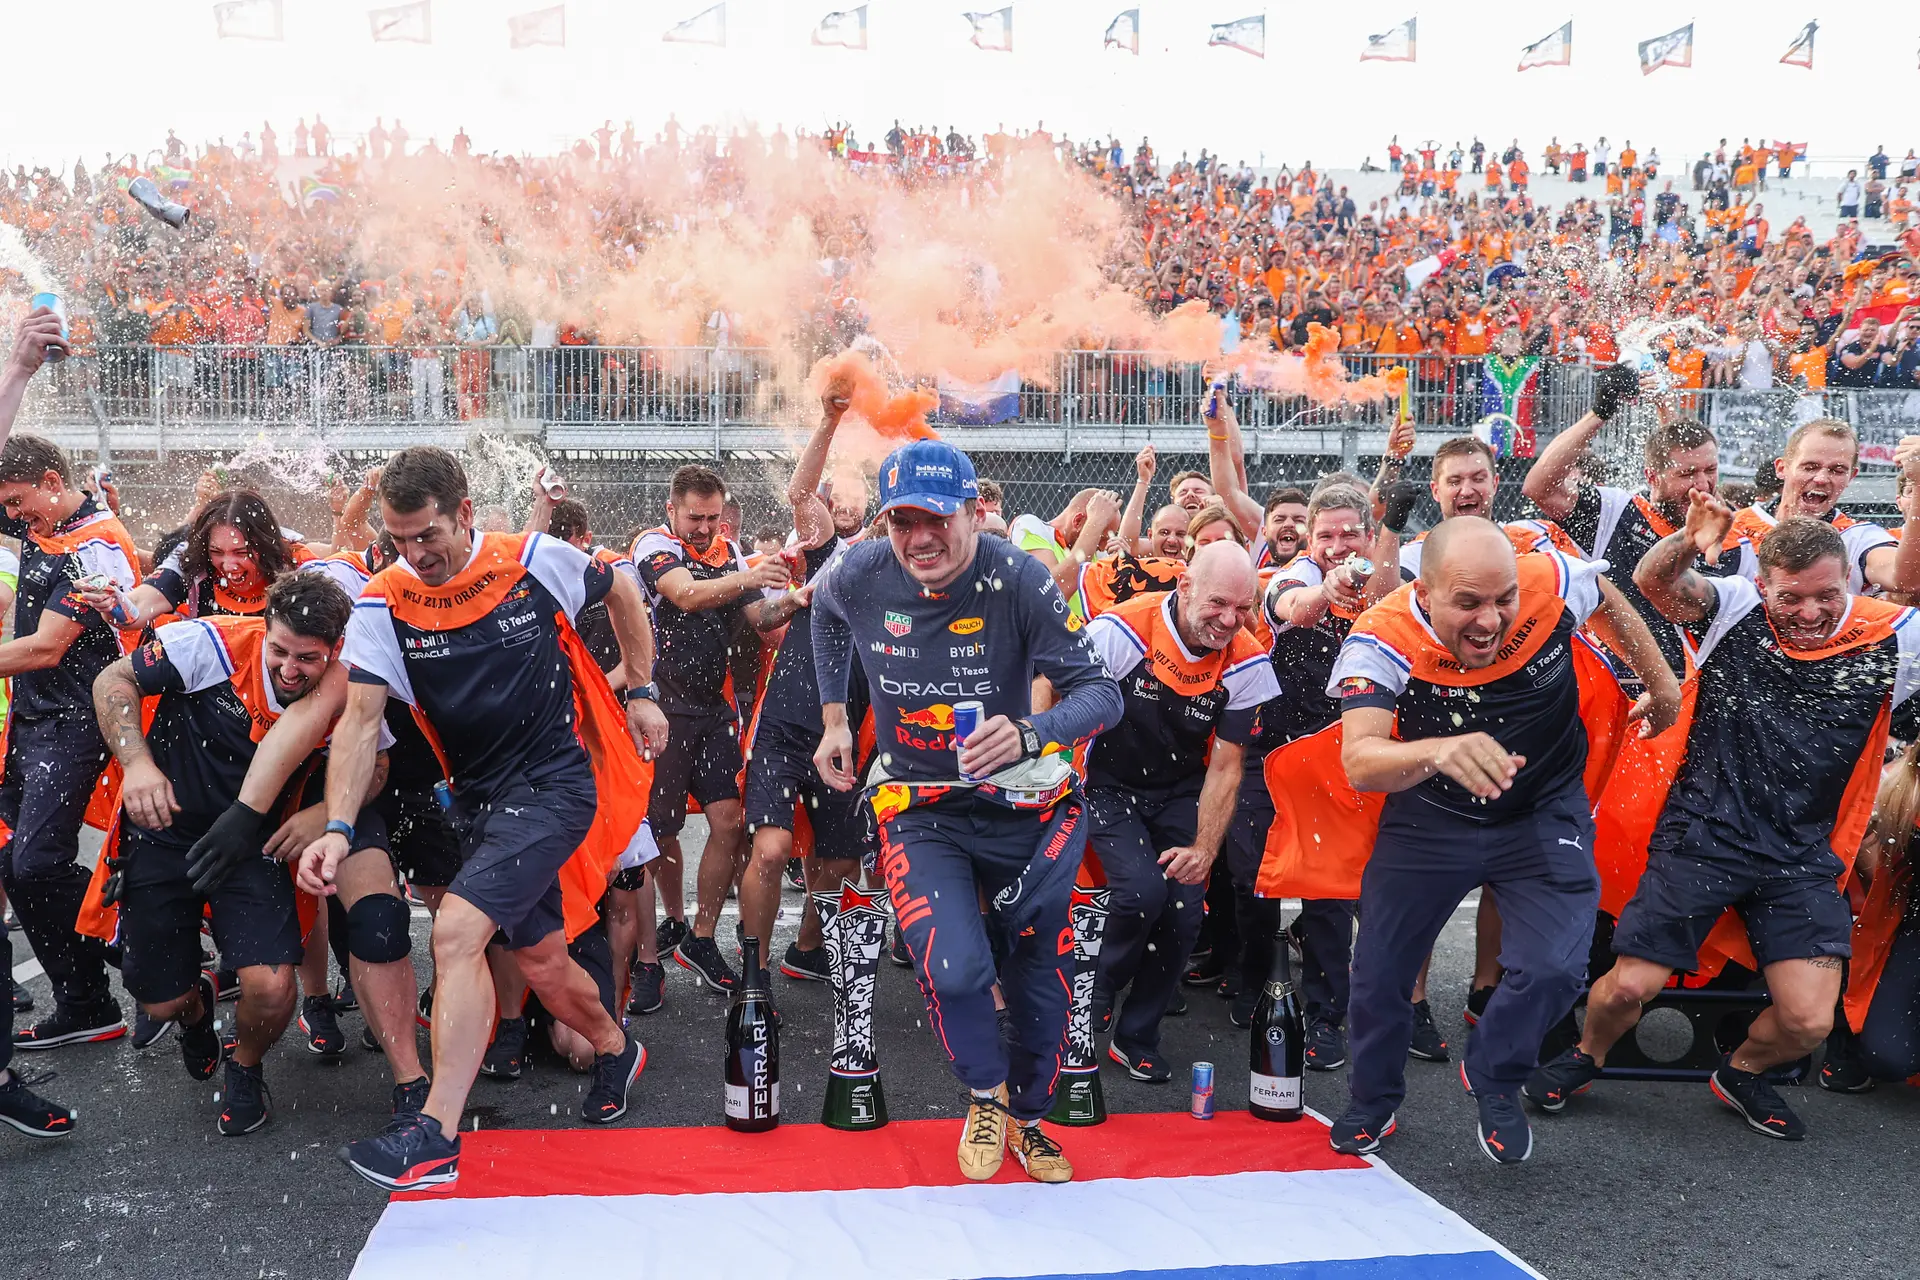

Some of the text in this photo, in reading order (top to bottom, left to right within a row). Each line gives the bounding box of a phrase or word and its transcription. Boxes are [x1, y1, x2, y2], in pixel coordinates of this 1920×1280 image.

[888, 467, 899, 488] 1
[402, 588, 422, 605] WIJ
[424, 596, 453, 609] ZIJN
[454, 570, 498, 605] ORANJE
[509, 611, 537, 627] Tezos
[887, 613, 910, 624] TAG
[958, 621, 981, 630] RAUCH
[886, 621, 911, 635] HEUER
[405, 636, 436, 649] Mobil
[1497, 616, 1538, 662] ORANJE
[408, 648, 451, 660] ORACLE
[875, 641, 906, 657] Mobil
[949, 642, 986, 658] BYBIT
[1537, 643, 1563, 667] Tezos
[1154, 649, 1169, 666] WIJ
[962, 666, 989, 676] Tezos
[881, 680, 993, 696] ORACLE
[1135, 677, 1159, 690] Mobil
[1431, 684, 1465, 698] Mobil
[1133, 688, 1161, 700] ORACL
[1190, 707, 1213, 721] Tezo
[895, 725, 946, 750] Red
[1044, 831, 1070, 860] WINGS
[885, 852, 933, 931] Bull
[1271, 1031, 1279, 1040] 1
[752, 1019, 768, 1119] FERRARI
[1253, 1086, 1295, 1099] FERRARI
[851, 1105, 873, 1118] 1
